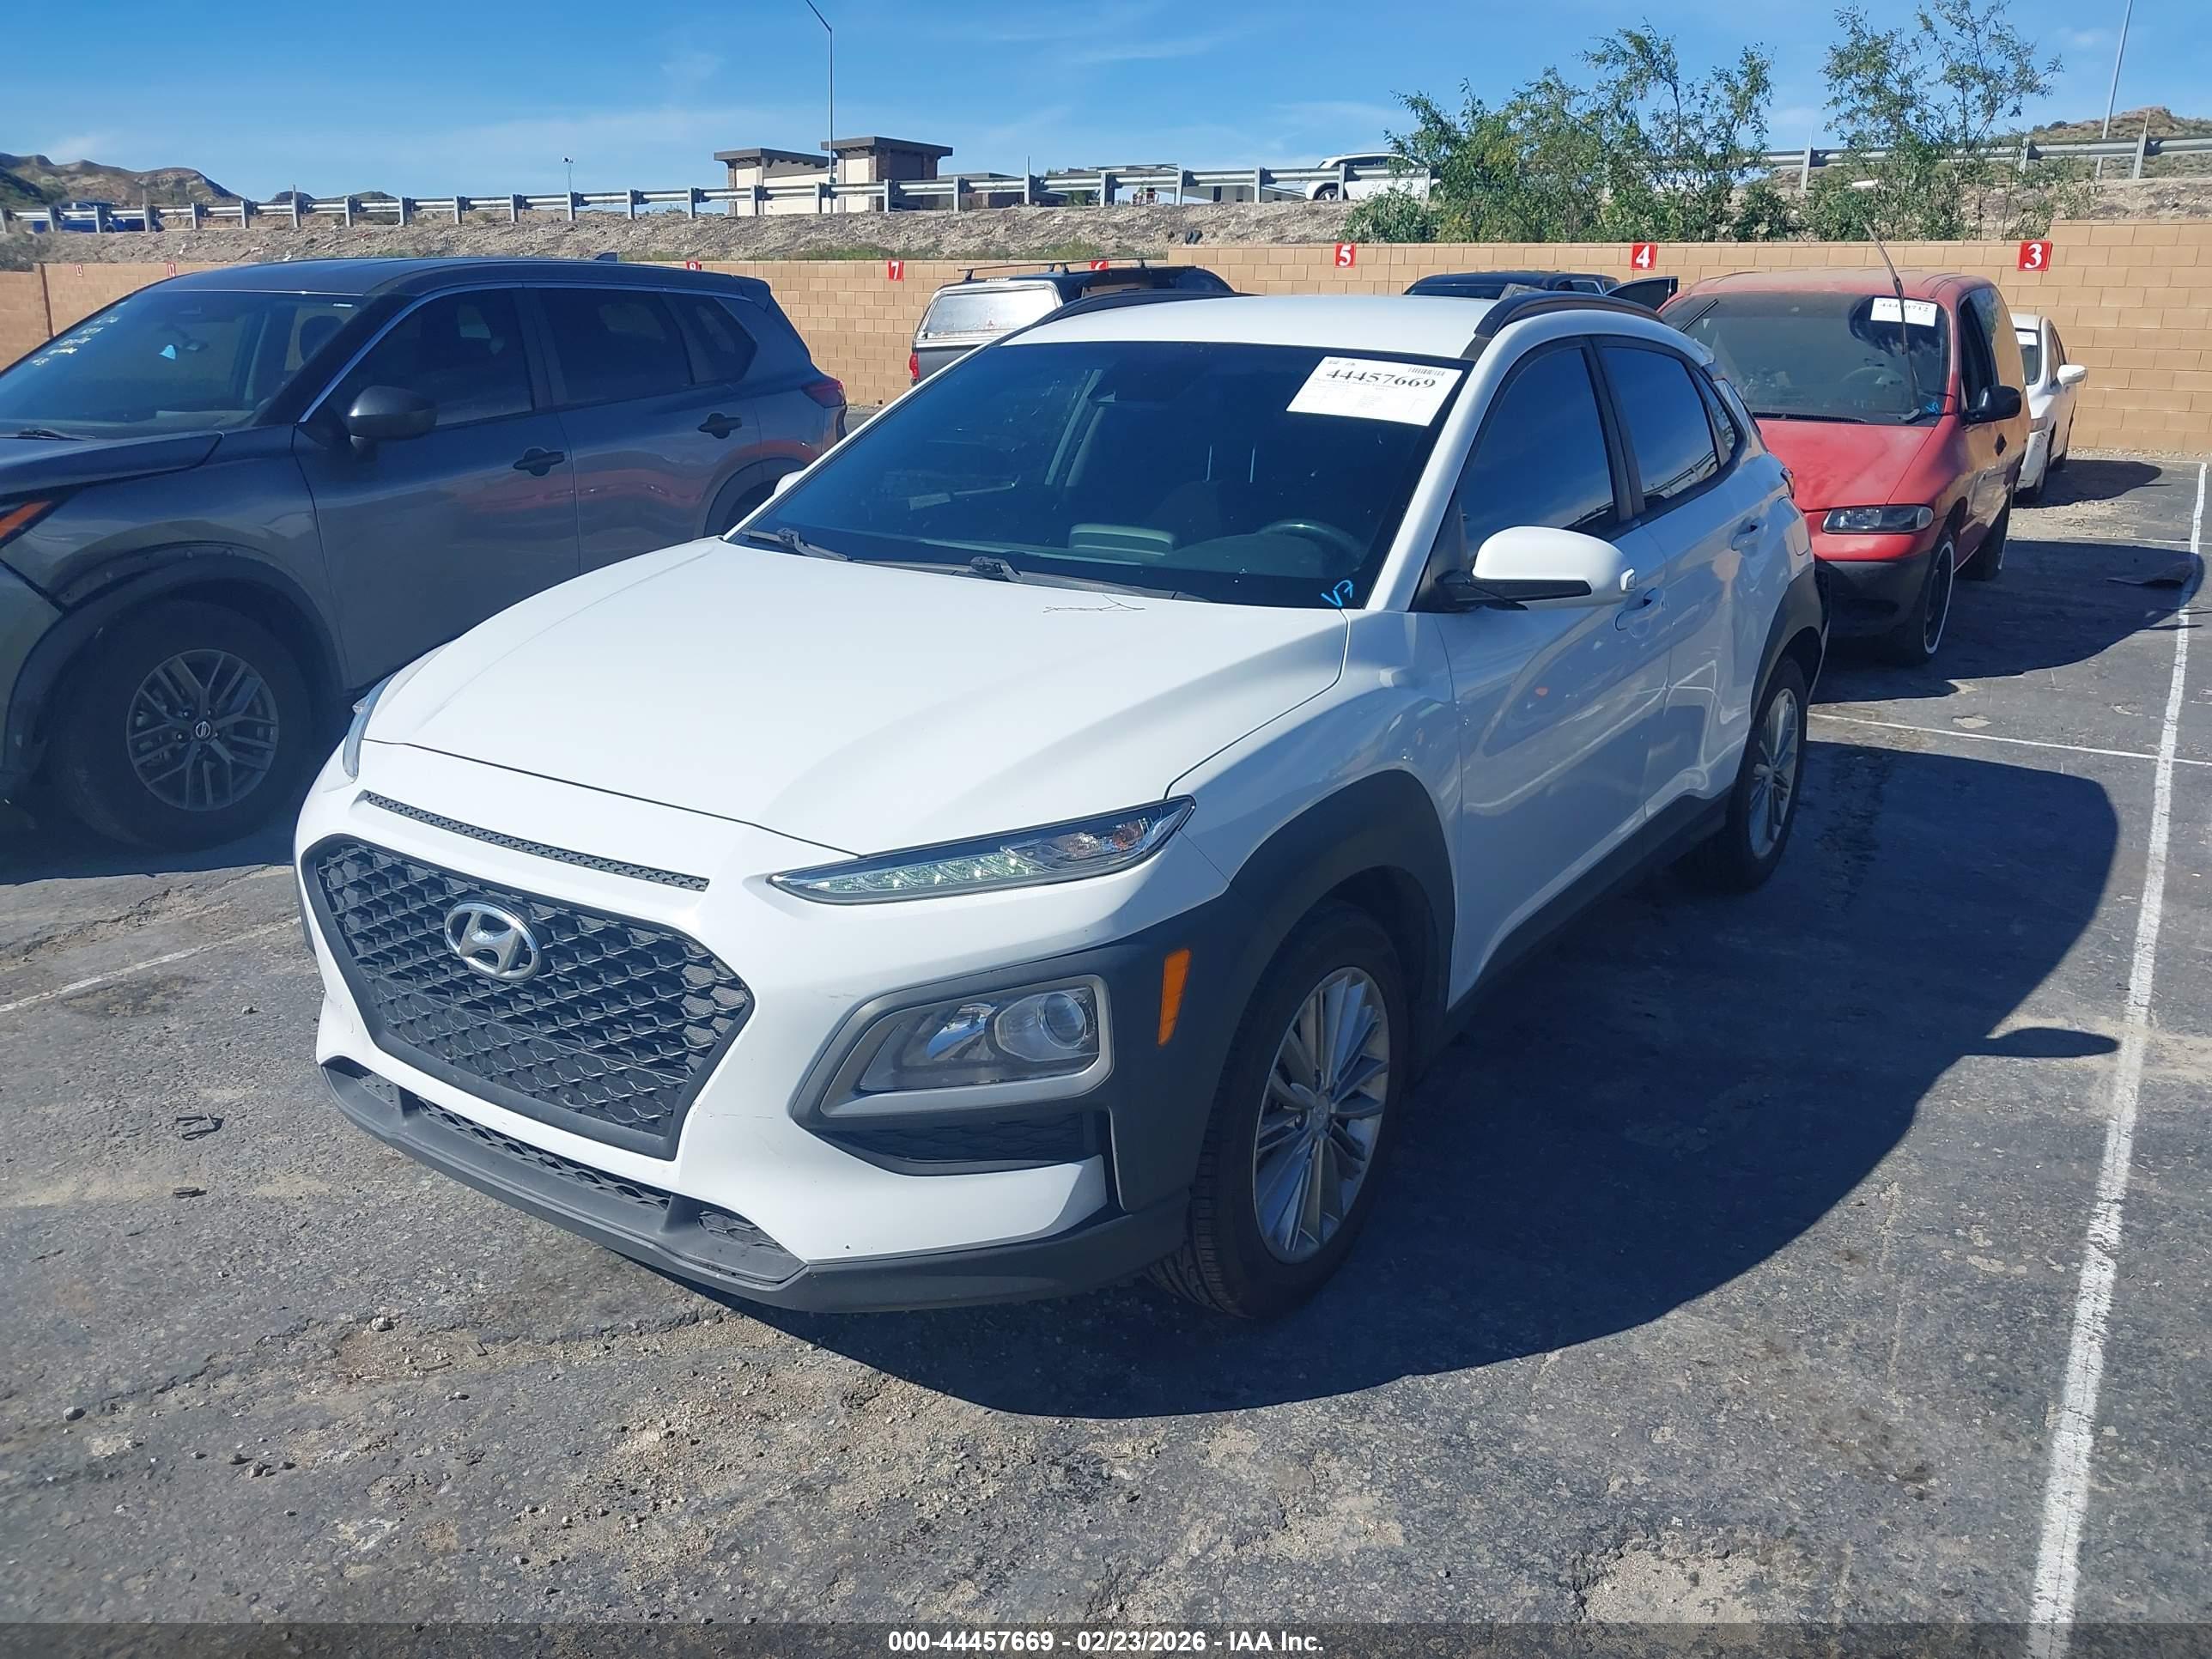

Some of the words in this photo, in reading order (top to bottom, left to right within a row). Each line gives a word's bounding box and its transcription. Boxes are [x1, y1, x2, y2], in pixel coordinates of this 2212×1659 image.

[1339, 244, 1352, 266] 5
[1636, 245, 1650, 268] 4
[2024, 243, 2042, 269] 3
[890, 260, 900, 281] 7
[1326, 369, 1437, 388] 44457669
